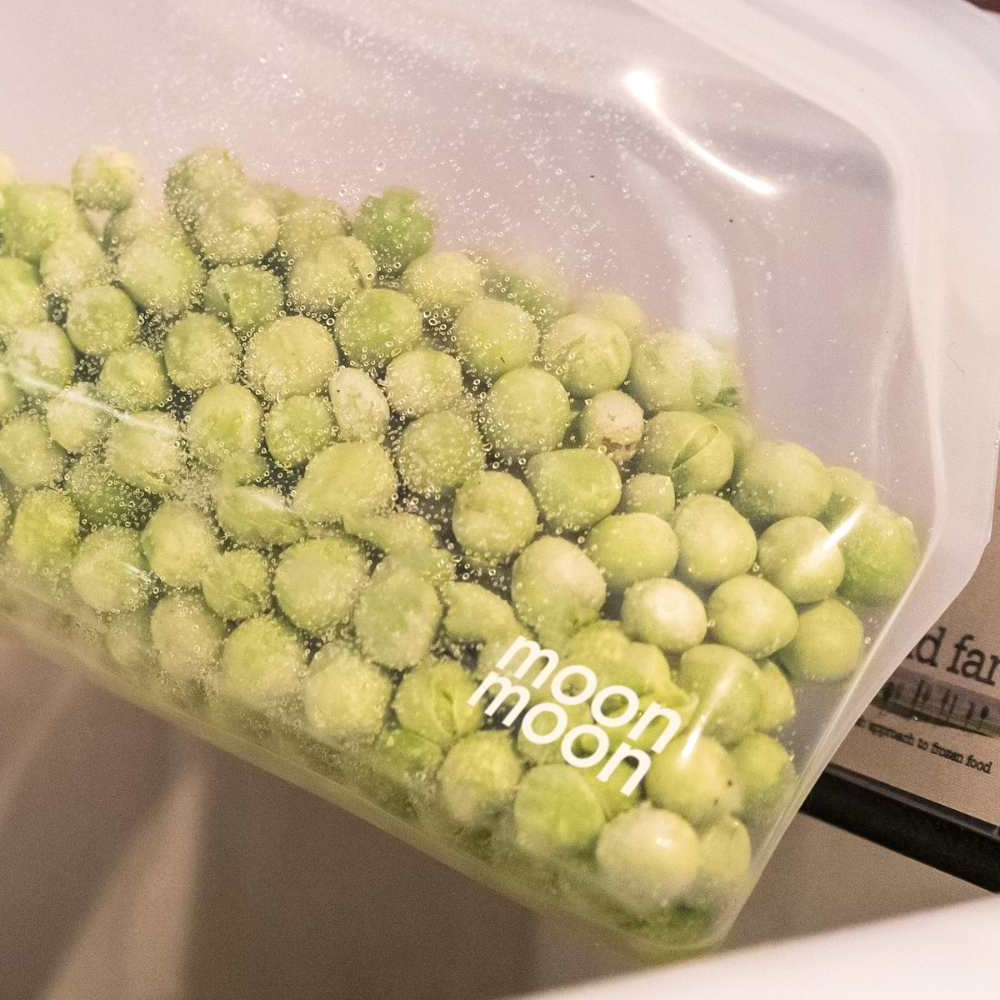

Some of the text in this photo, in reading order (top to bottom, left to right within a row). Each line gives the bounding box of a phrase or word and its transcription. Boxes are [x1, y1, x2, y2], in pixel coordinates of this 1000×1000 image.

[907, 626, 946, 667] d
[467, 671, 651, 796] moon
[495, 635, 682, 754] moon
[868, 722, 992, 774] approach to frozen food
